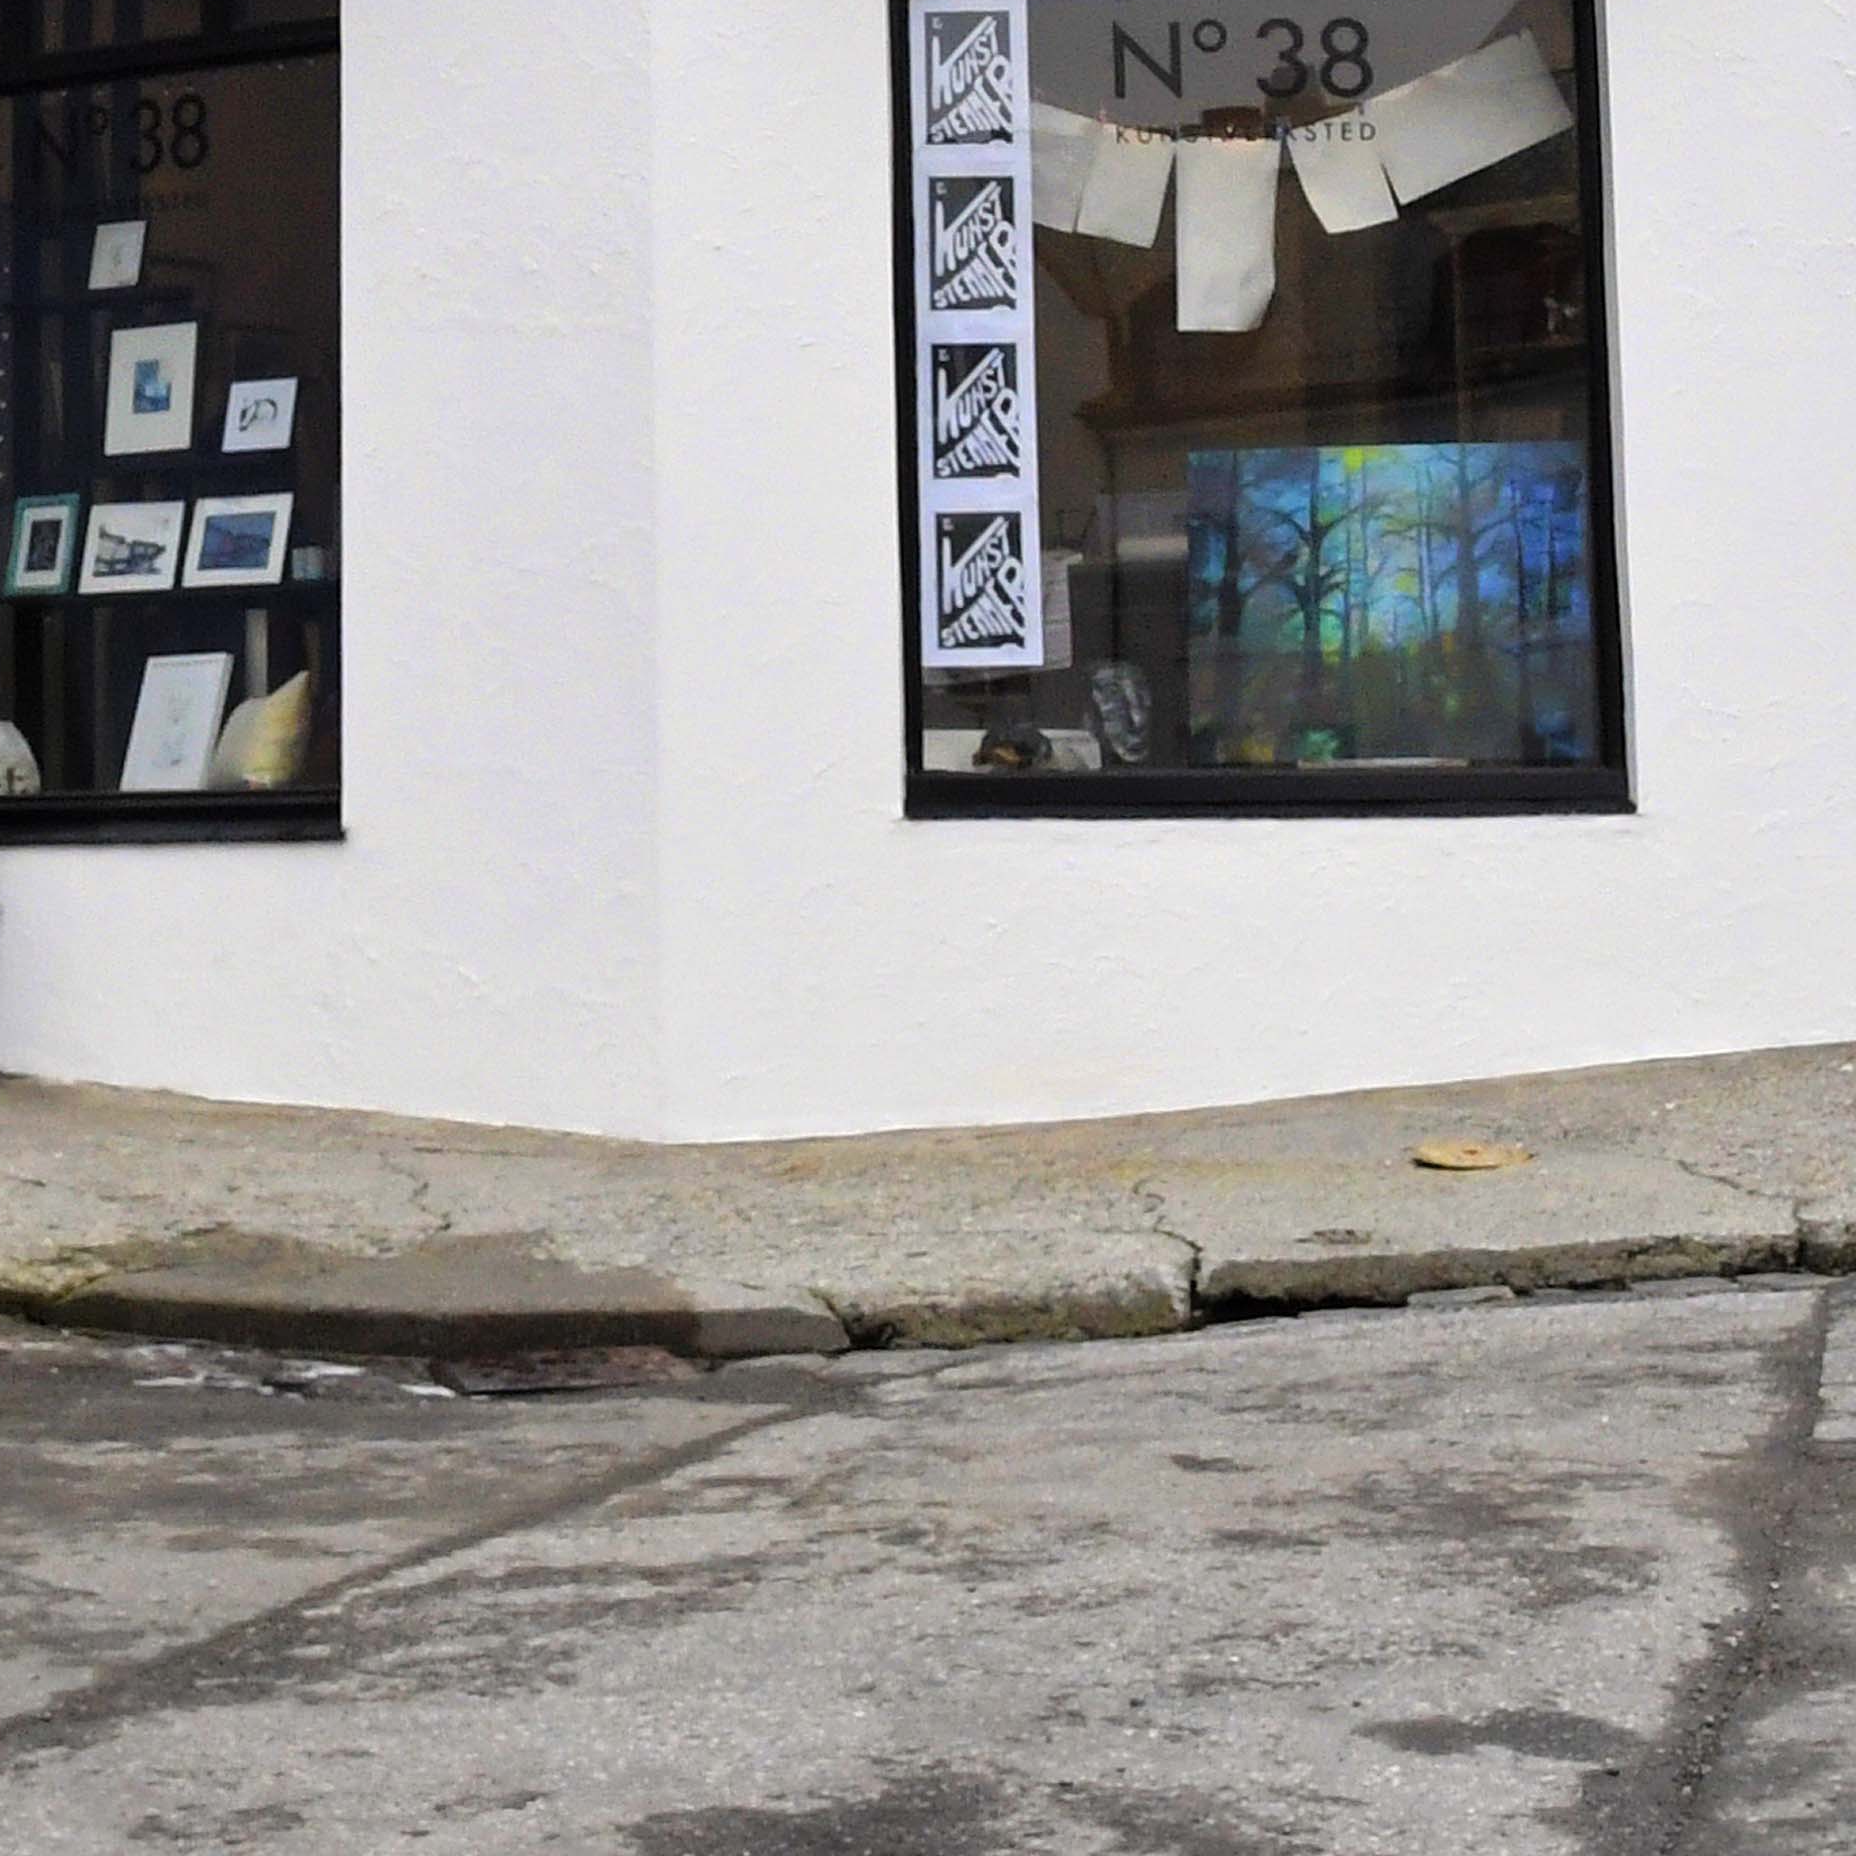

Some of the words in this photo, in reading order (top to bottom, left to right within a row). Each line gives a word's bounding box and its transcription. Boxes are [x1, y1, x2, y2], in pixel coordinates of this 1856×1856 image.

[932, 16, 998, 109] KUNST
[1256, 17, 1374, 97] 38
[131, 93, 210, 174] 38
[1116, 122, 1377, 144] KUSSTED
[935, 181, 1002, 276] KUNST
[938, 348, 1005, 444] KUNST
[942, 516, 1009, 614] KUNST
